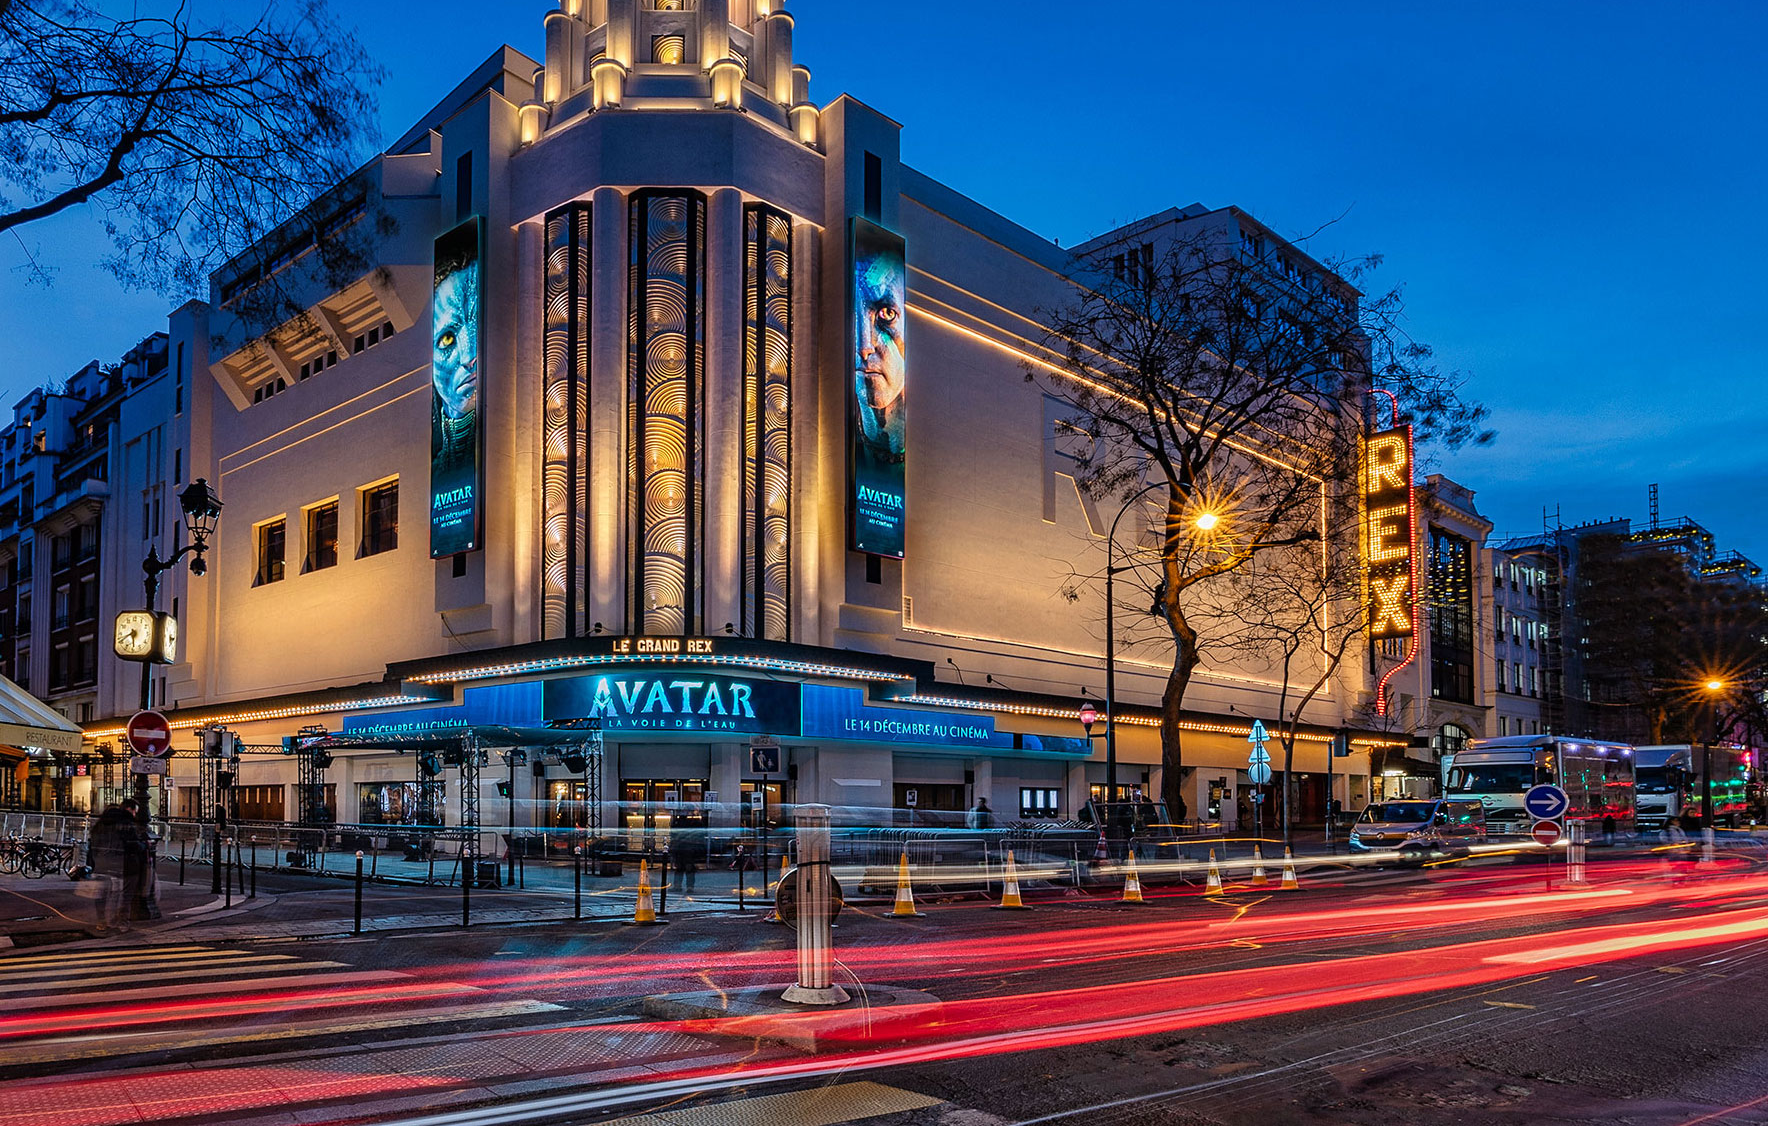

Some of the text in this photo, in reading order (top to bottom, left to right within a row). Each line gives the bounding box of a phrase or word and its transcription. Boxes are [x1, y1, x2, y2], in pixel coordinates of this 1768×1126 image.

[433, 485, 473, 509] AVATAR
[857, 485, 903, 510] AVATAR
[1367, 435, 1412, 633] REX
[612, 639, 713, 653] LE GRAND REX
[587, 677, 756, 719] AVATAR
[608, 719, 736, 729] LA VOIE DE L'EAU
[845, 718, 989, 740] LE 14 DÉCEMBRE AU CINÉMA
[25, 731, 73, 747] RESTAURANT
